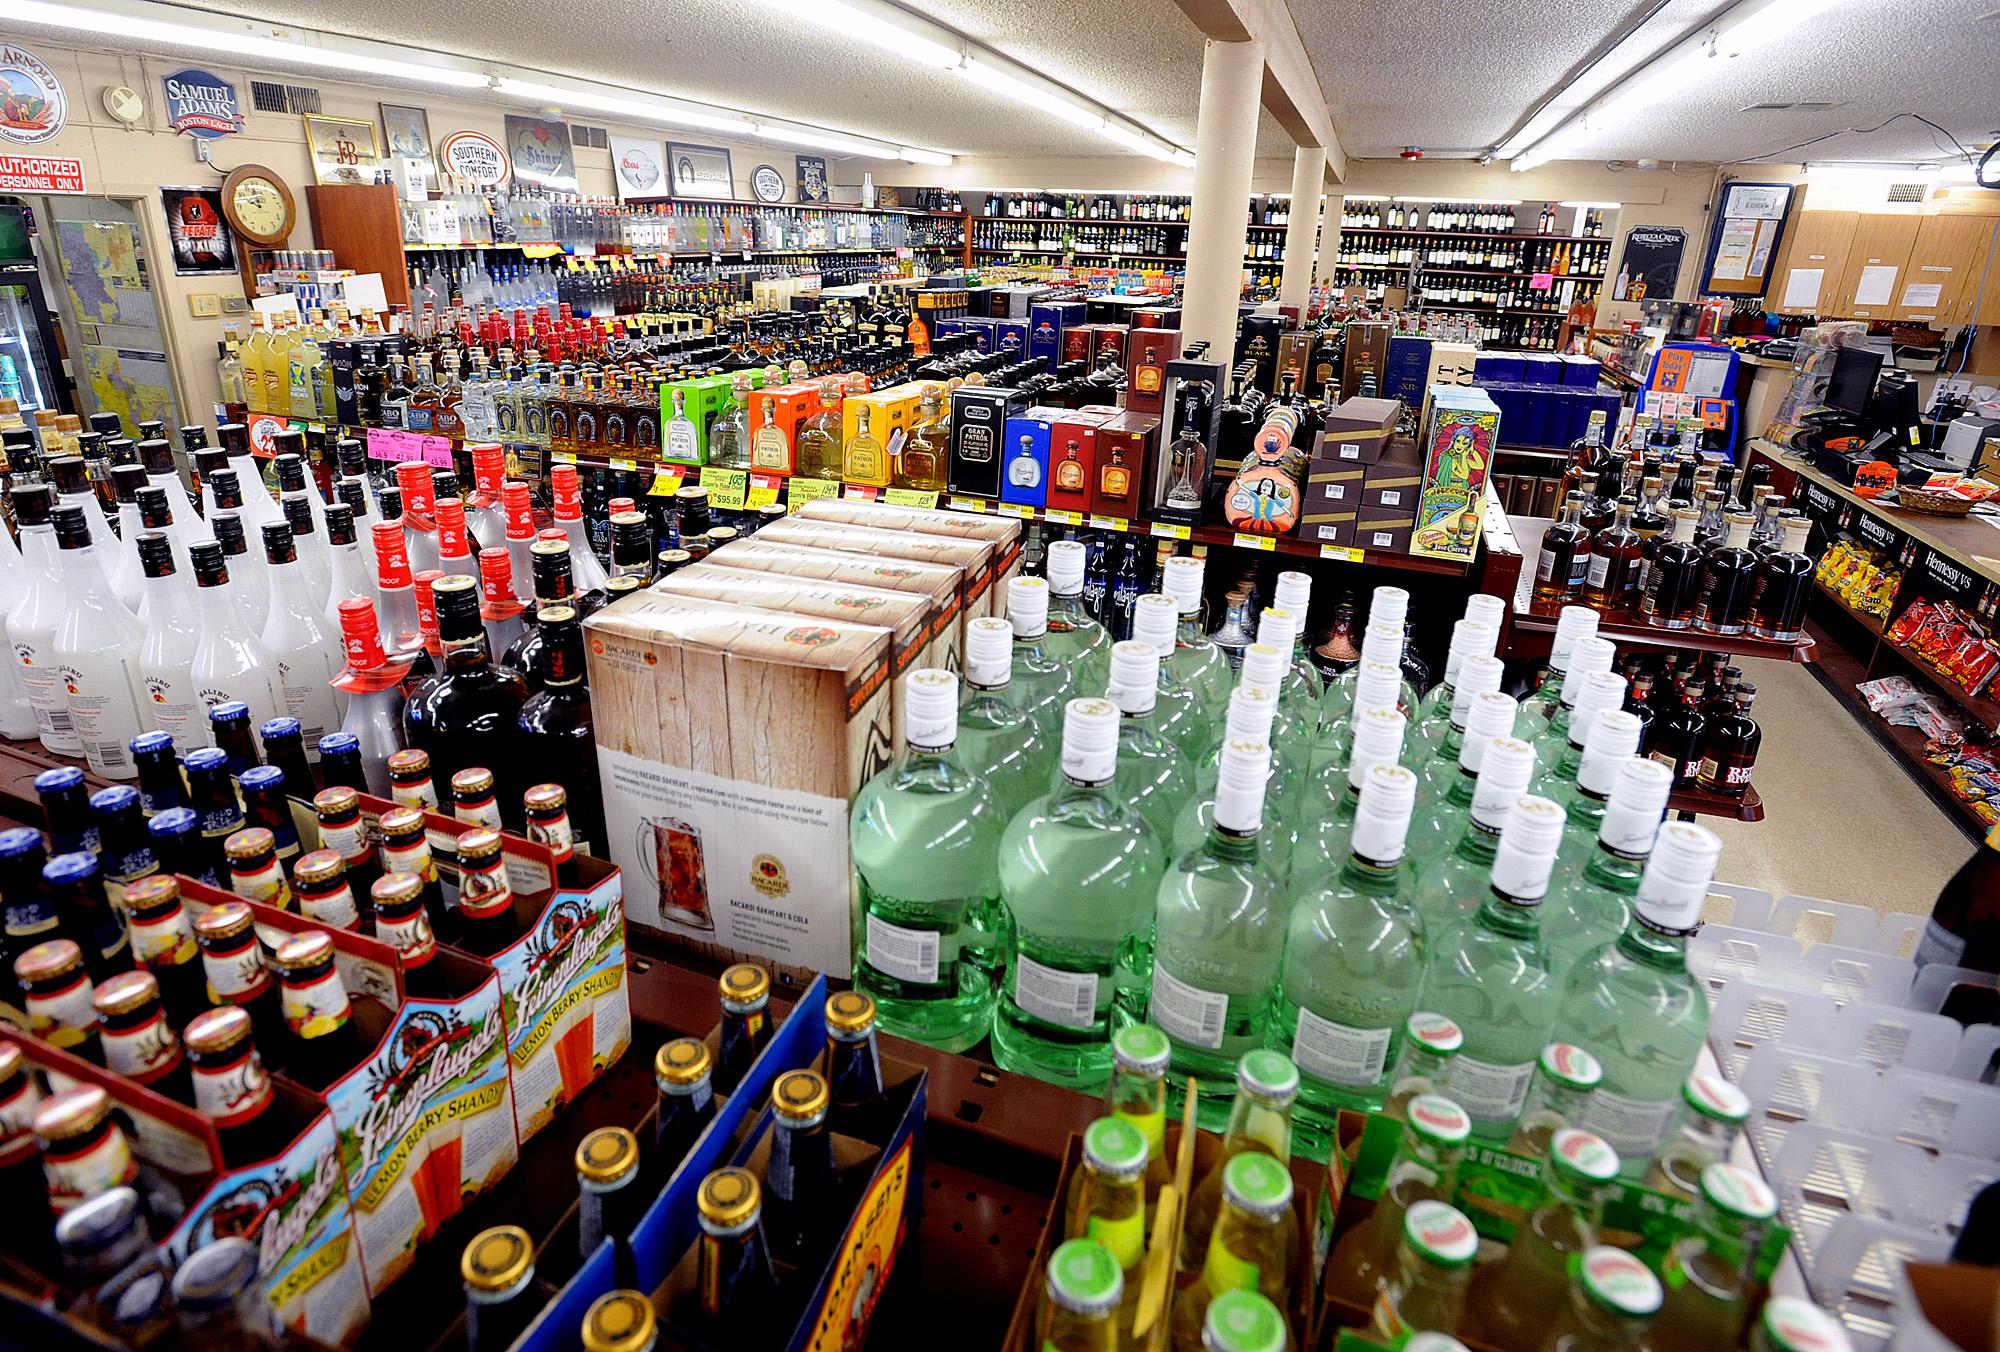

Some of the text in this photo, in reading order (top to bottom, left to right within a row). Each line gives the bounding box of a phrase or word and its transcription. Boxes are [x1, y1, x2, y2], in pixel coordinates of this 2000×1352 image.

[3, 47, 56, 90] ARNOLD
[167, 79, 235, 104] SAMUEL
[178, 98, 233, 120] ADAMS
[177, 117, 237, 131] BOSTON LAGER
[453, 146, 498, 162] SOUTHERN
[526, 144, 562, 166] Shiner
[460, 164, 498, 179] COMFORT
[622, 158, 640, 169] Coors
[56, 177, 80, 190] ONLY
[178, 239, 225, 252] BOXING
[1667, 352, 1684, 361] Play
[967, 427, 986, 435] GRAN
[430, 458, 448, 467] 45.99
[717, 494, 741, 505] $95.99
[1808, 483, 1829, 505] Hennessy
[1859, 513, 1886, 541] Hennessy
[1925, 551, 1960, 582] Hennessy
[379, 577, 400, 585] PROOF
[605, 643, 641, 659] BACARDI
[199, 688, 230, 701] MALIBU
[849, 675, 875, 712] SPICED
[640, 770, 661, 782] BACARDI
[751, 875, 788, 889] BACARDI
[730, 899, 755, 911] BACARDI
[756, 905, 787, 919] OAKHEART
[793, 914, 809, 925] COLA
[507, 895, 622, 1046] Leinenkugel's
[515, 971, 619, 1062] LEMON BERRY SHANDY
[348, 1001, 501, 1191] Leinenkugel's
[405, 1107, 445, 1152] BERRY
[447, 1086, 500, 1118] SHANDY
